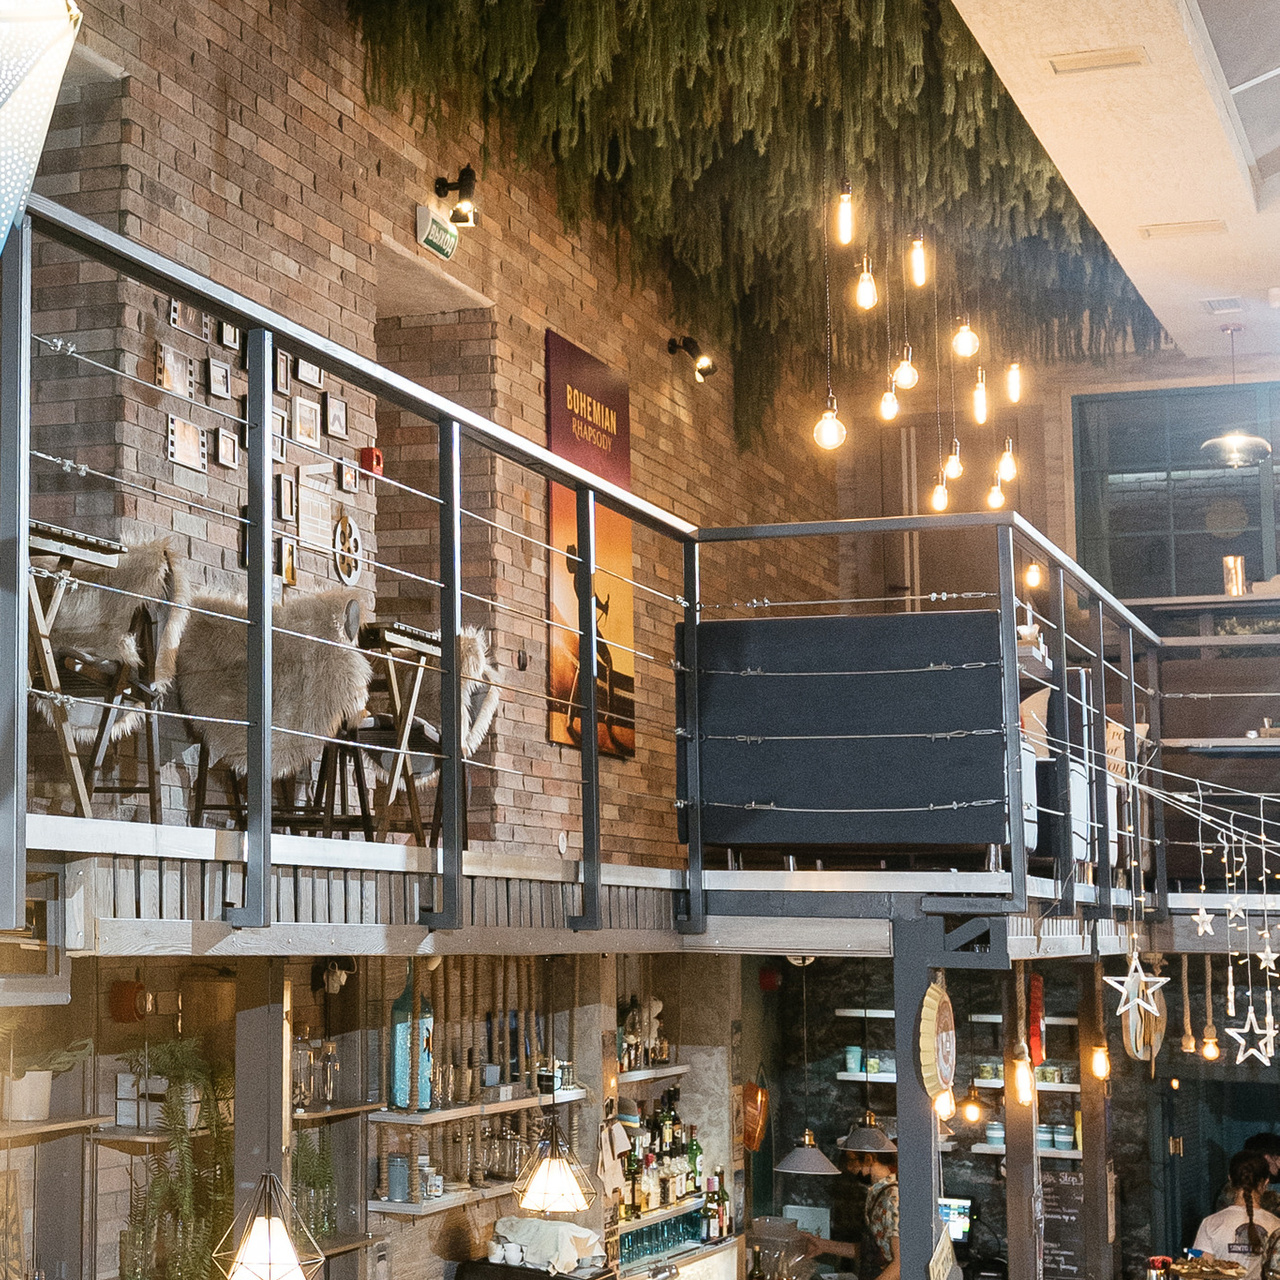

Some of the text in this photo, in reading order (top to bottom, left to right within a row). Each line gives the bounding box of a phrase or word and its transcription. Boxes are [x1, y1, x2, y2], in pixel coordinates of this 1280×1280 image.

[428, 224, 456, 256] ВЫХОД
[566, 384, 617, 436] BOHEMIAN
[572, 417, 613, 453] RHAPSODY
[1107, 747, 1121, 756] of
